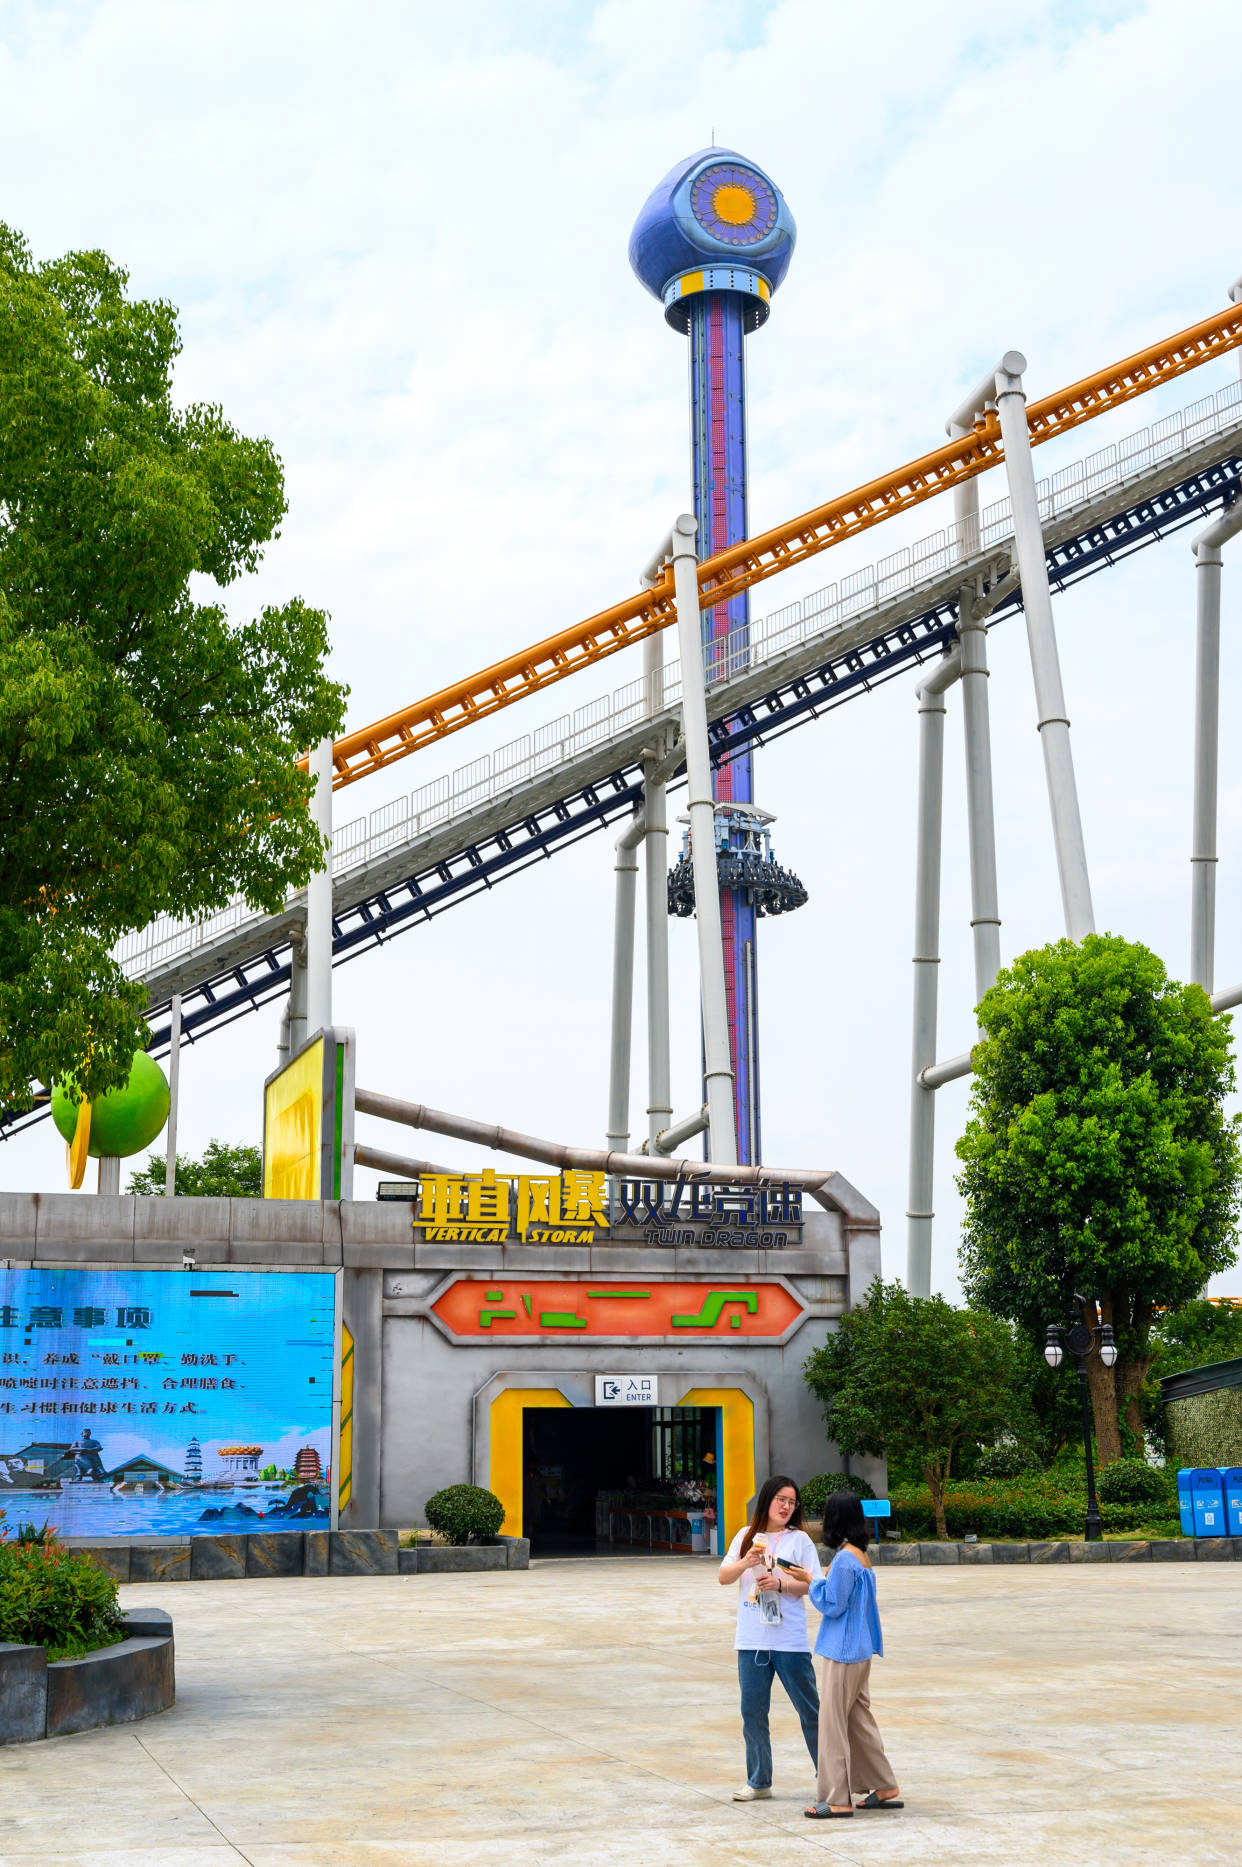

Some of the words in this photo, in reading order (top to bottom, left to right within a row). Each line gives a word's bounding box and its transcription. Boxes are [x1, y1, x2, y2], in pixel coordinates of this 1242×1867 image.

[413, 1168, 611, 1242] 垂直风暴
[425, 1227, 508, 1242] VERTICAL
[527, 1230, 595, 1244] STORM
[646, 1229, 697, 1246] TWIN
[627, 1379, 651, 1390] 入口
[626, 1393, 652, 1401] ENTER
